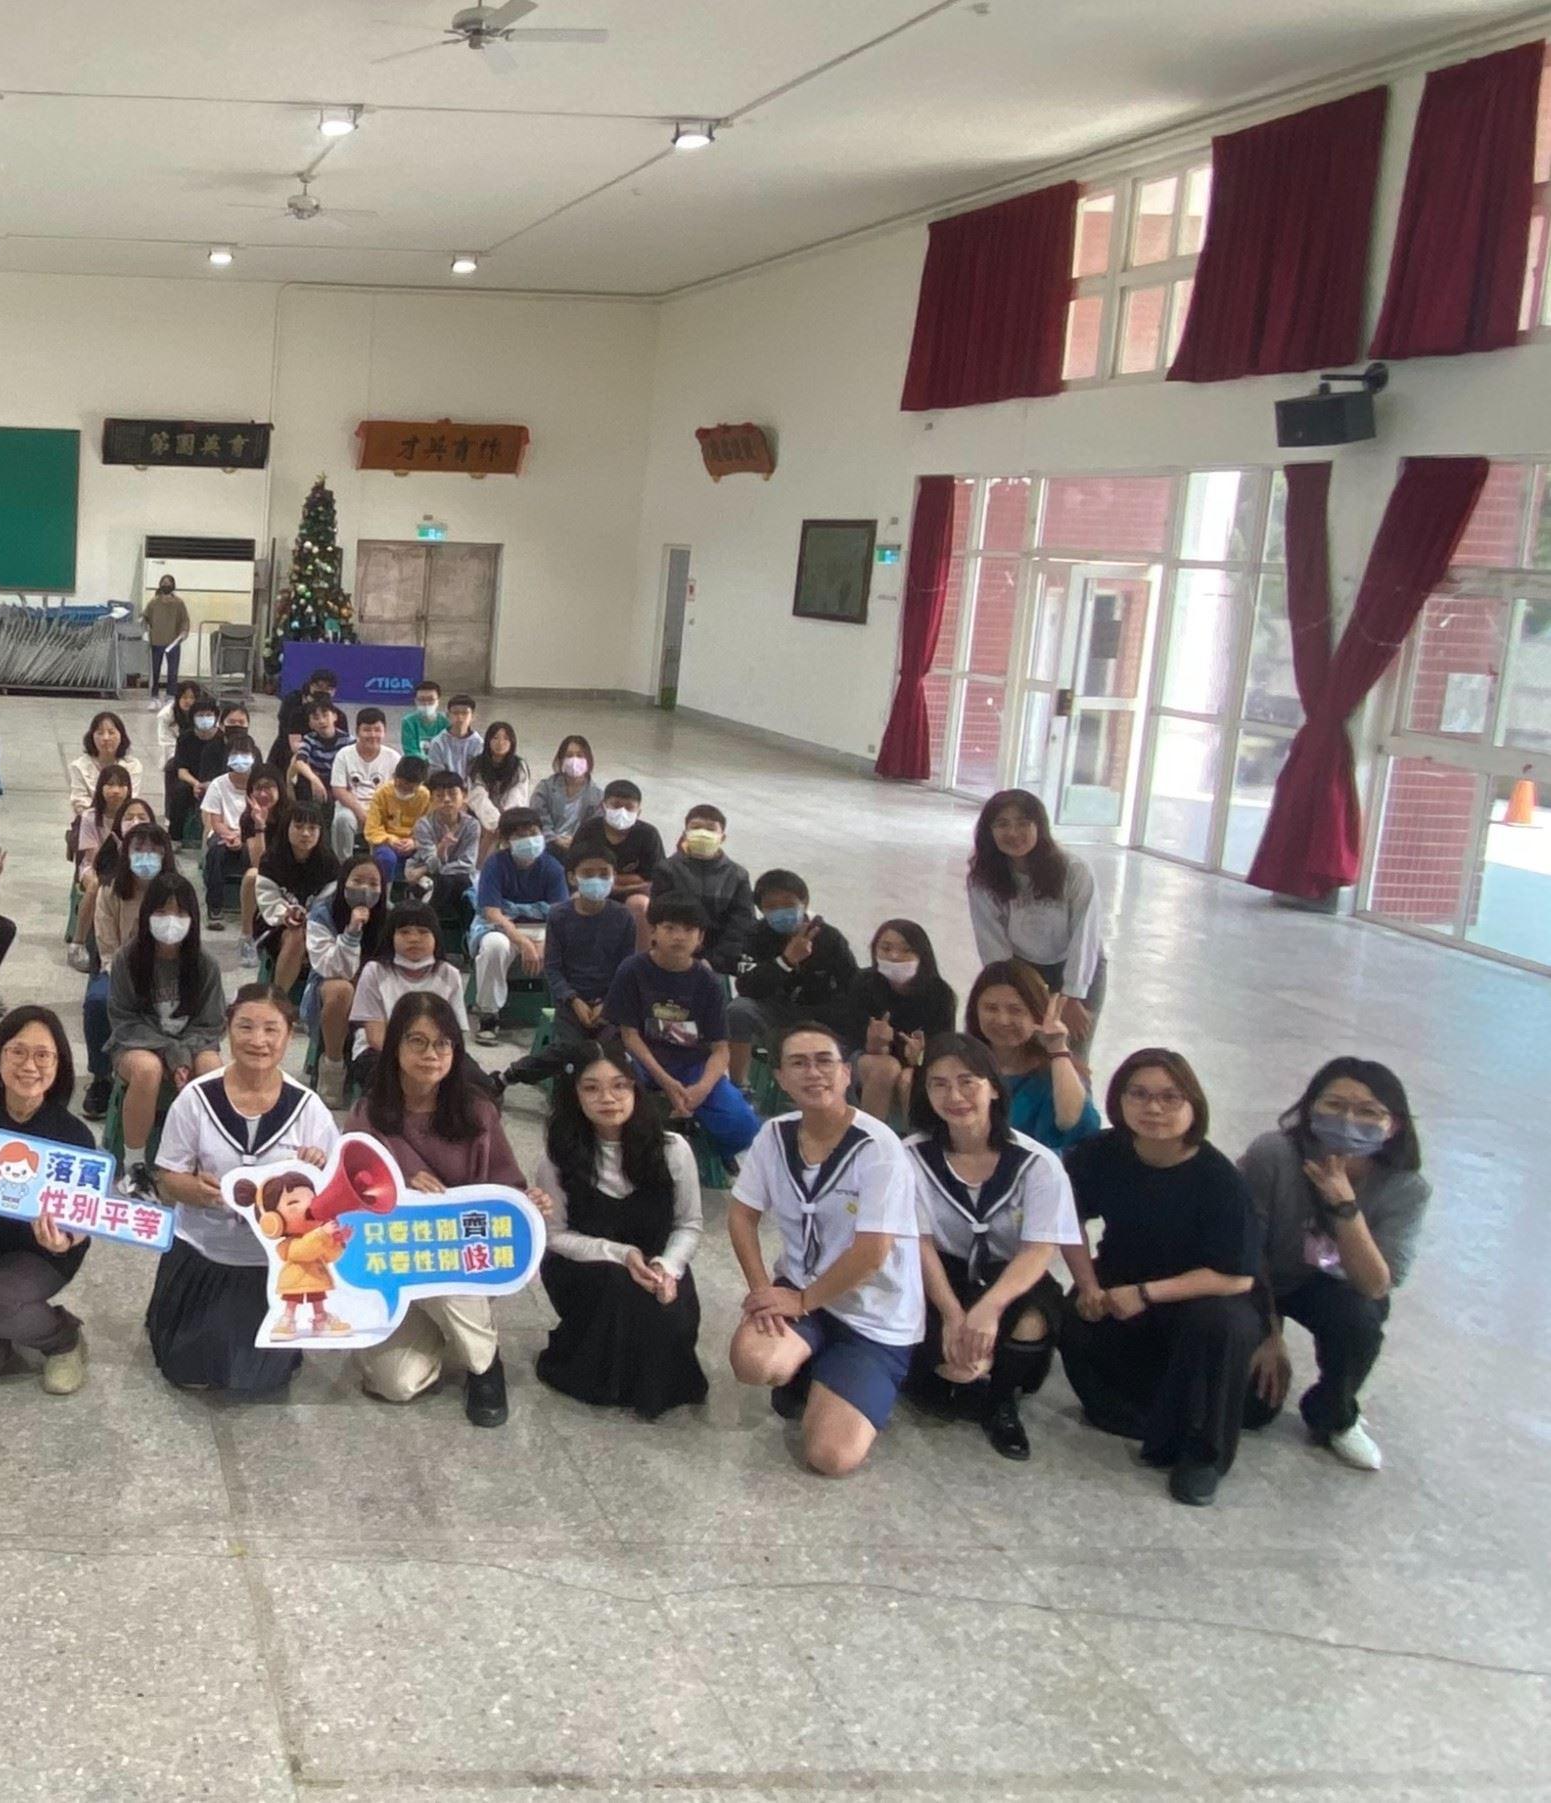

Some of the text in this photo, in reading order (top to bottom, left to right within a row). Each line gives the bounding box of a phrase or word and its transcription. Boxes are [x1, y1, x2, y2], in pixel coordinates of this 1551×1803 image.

[46, 1151, 107, 1190] 落實
[39, 1186, 162, 1239] 性別平等
[365, 1244, 515, 1275] 不要性別歧視
